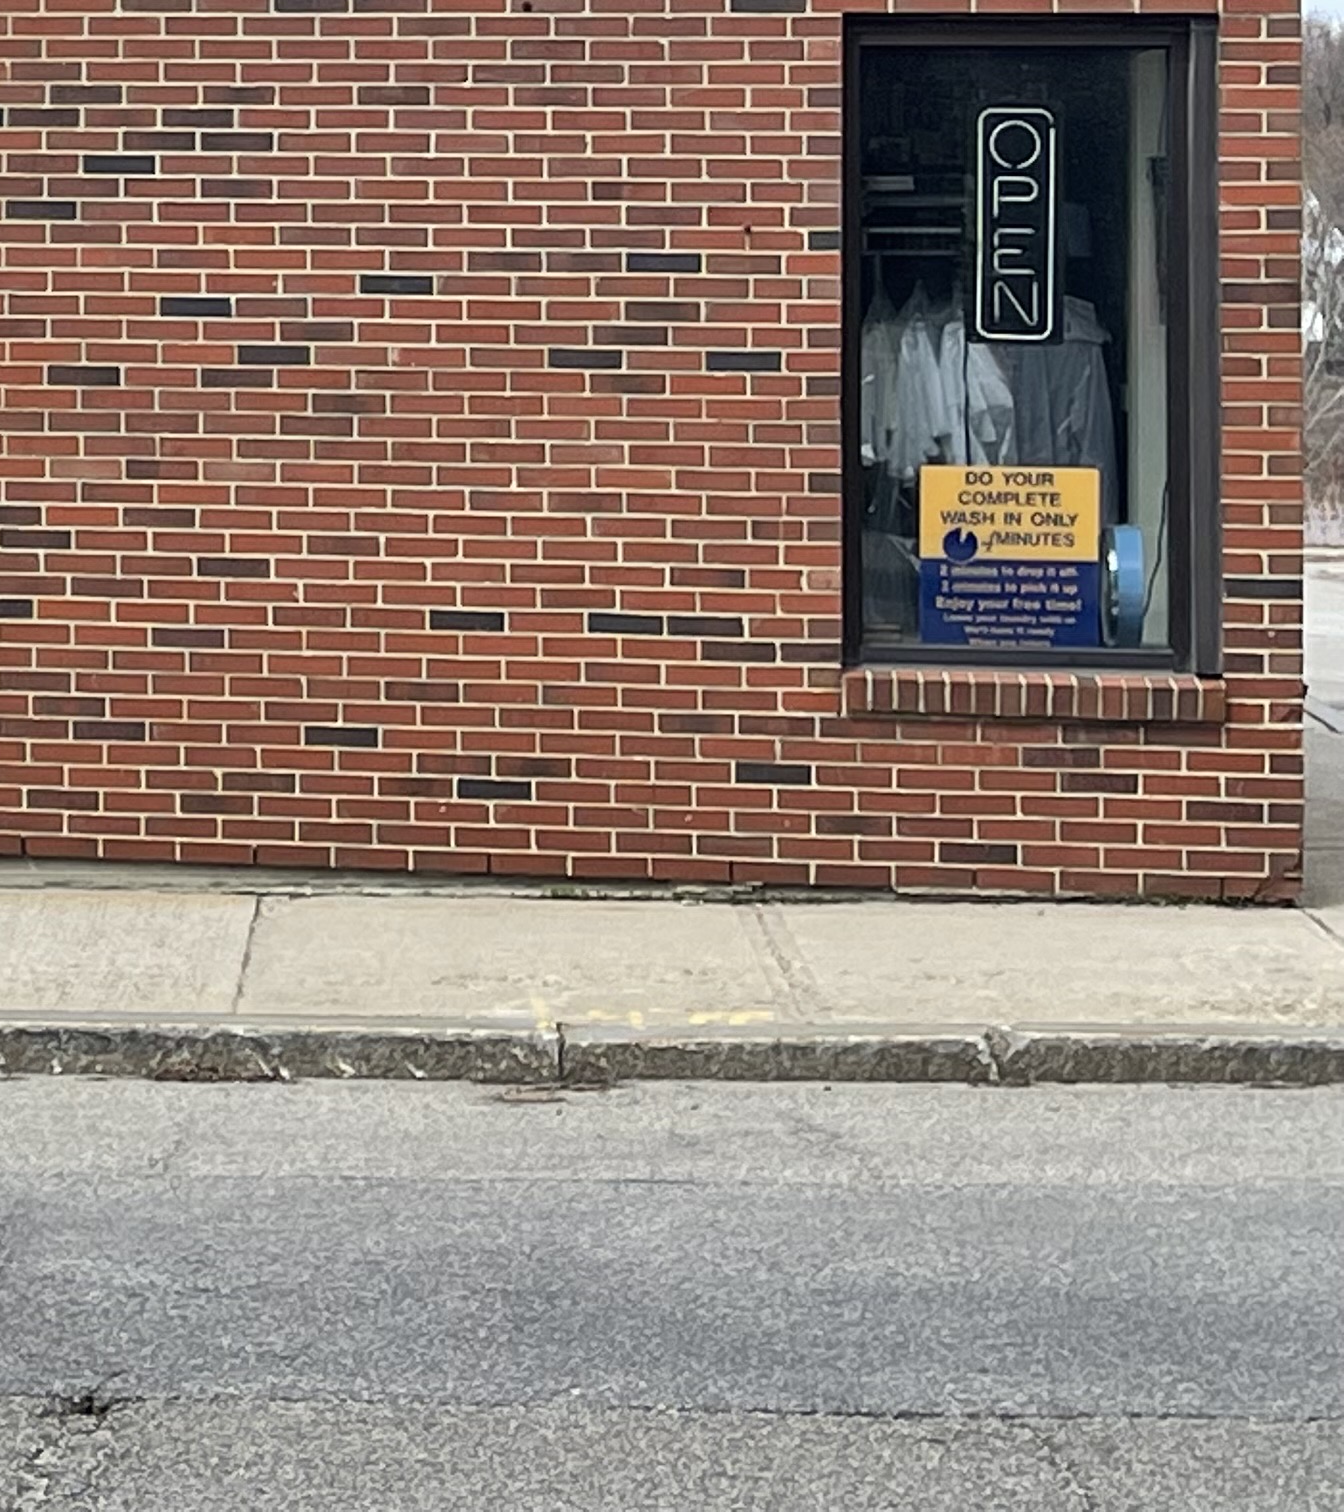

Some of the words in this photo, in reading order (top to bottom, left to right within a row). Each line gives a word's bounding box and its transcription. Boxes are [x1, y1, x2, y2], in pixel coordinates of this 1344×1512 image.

[989, 119, 1041, 327] OPEN
[965, 471, 993, 486] DO
[1002, 472, 1054, 486] YOUR
[958, 491, 1061, 507] COMPLETE
[940, 511, 995, 526] WASH
[1003, 511, 1022, 526] IN
[1030, 511, 1079, 527] ONLY
